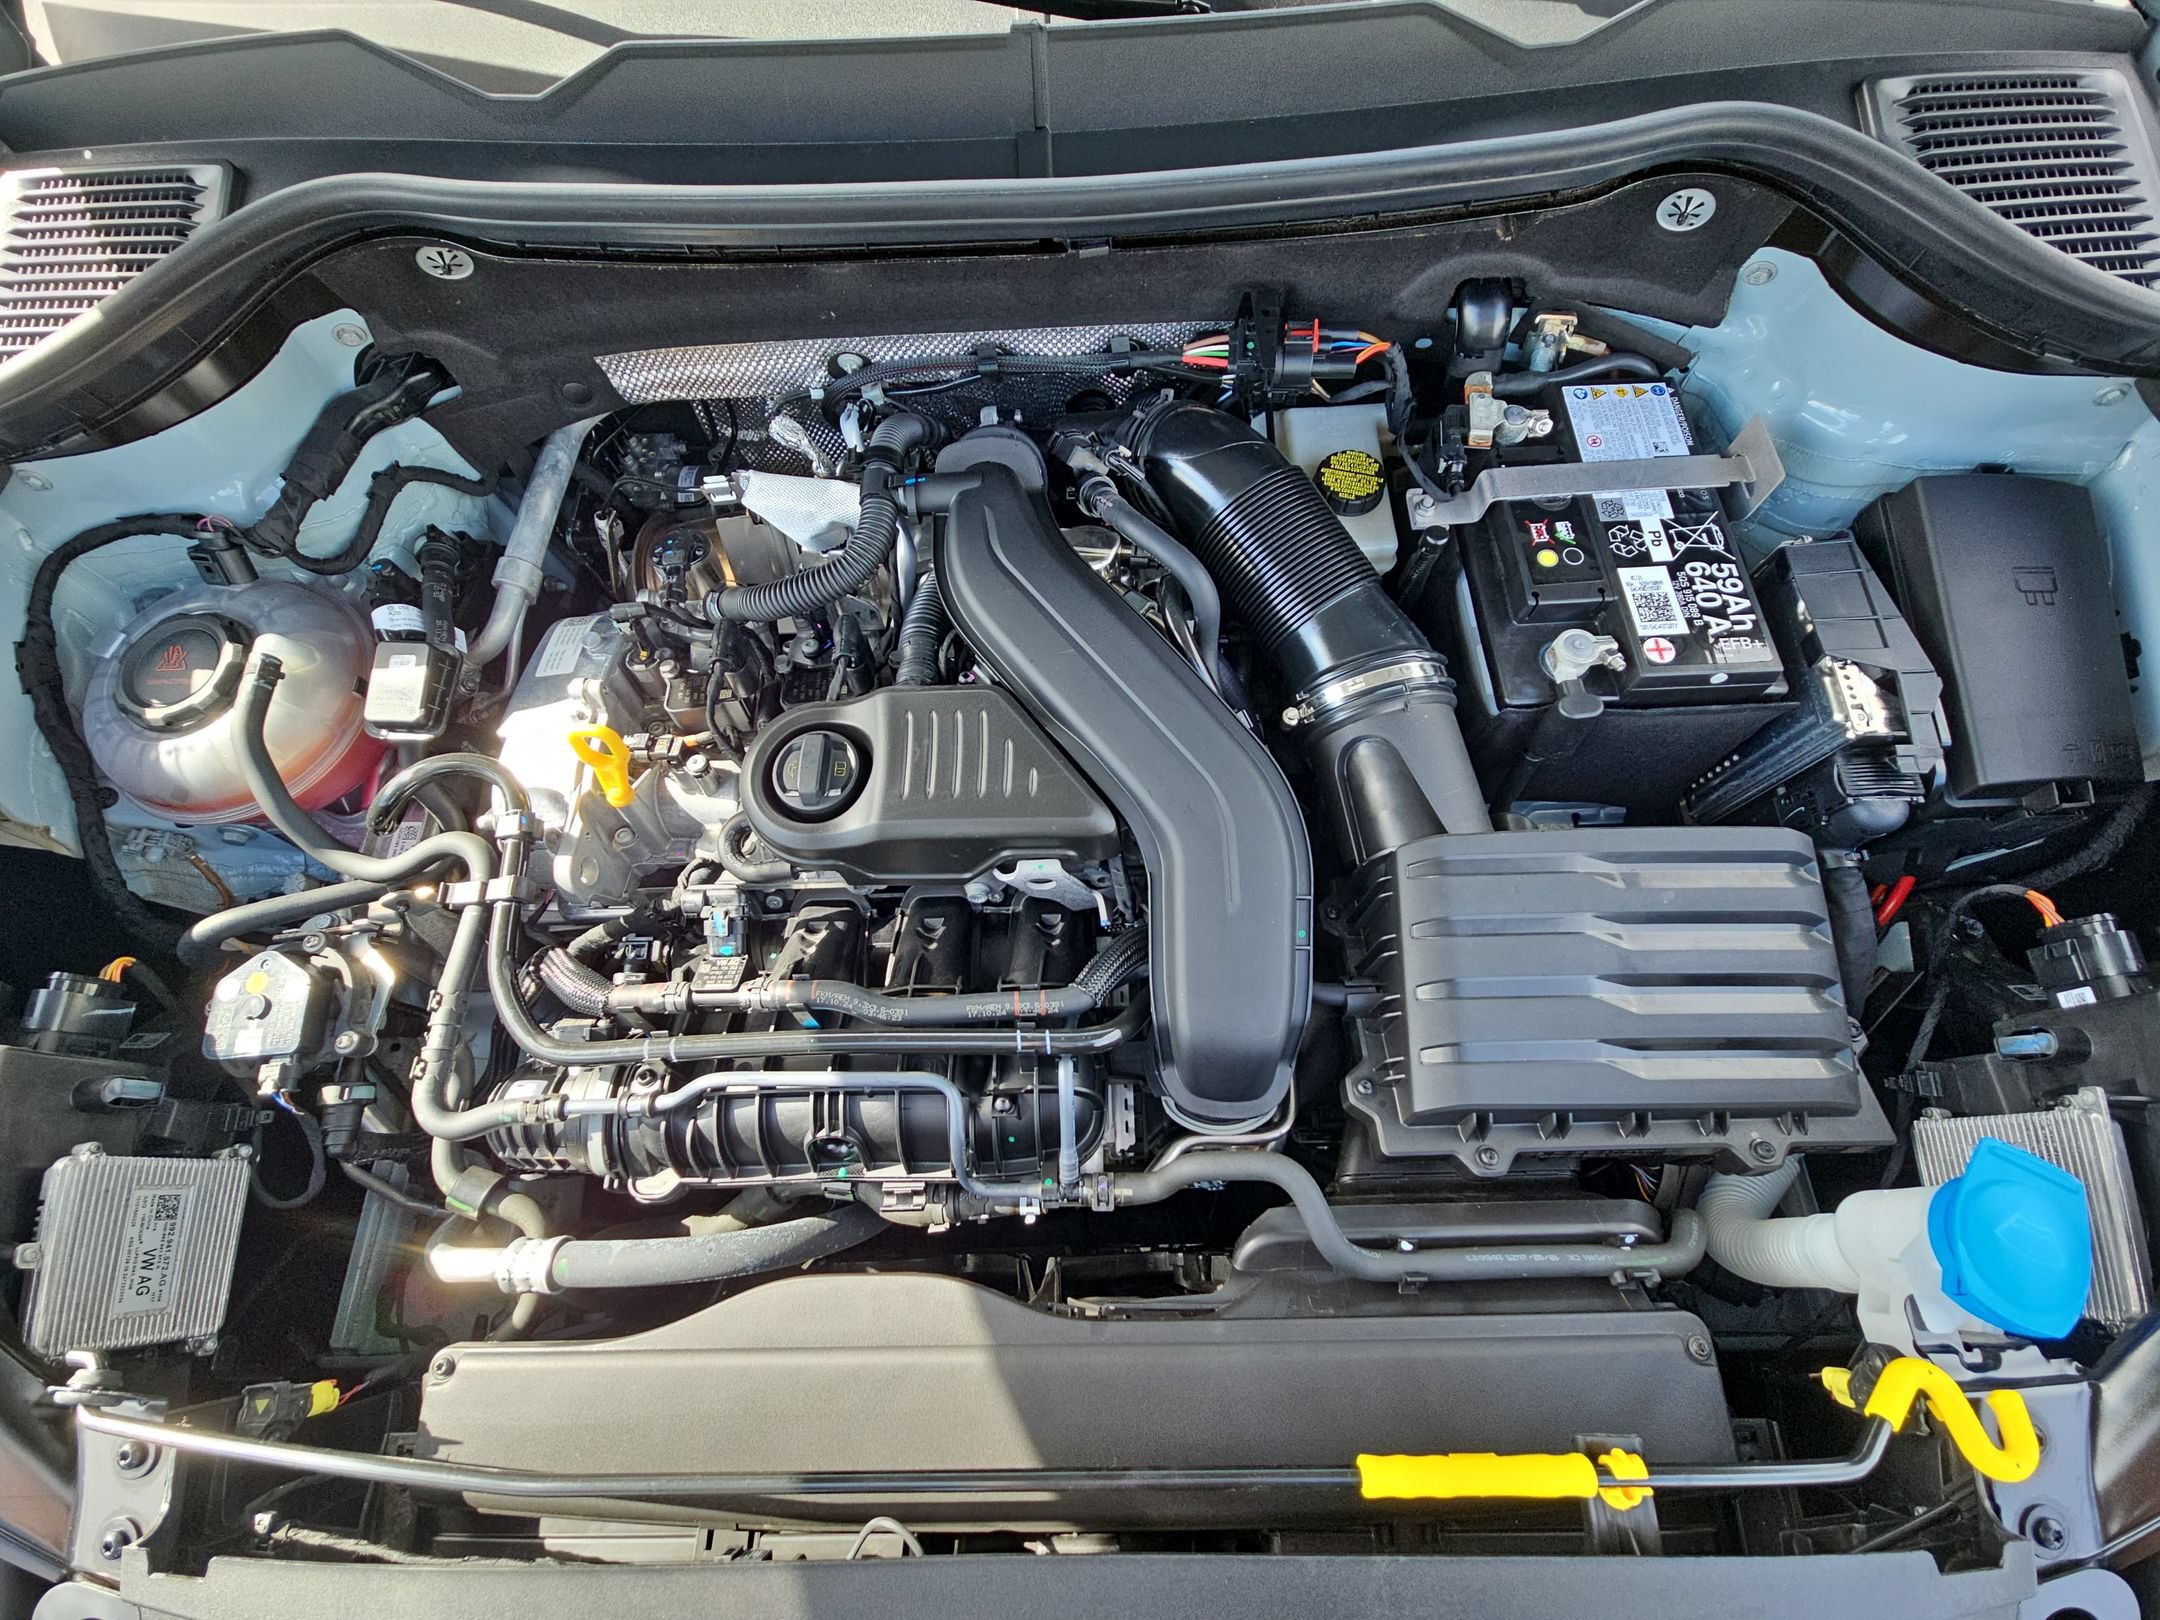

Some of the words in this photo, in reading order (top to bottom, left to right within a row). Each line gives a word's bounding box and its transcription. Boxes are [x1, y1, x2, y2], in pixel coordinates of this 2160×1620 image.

[1670, 396, 1695, 447] DANGER/POISON
[1648, 530, 1663, 547] Pb
[1685, 561, 1723, 608] 640
[1711, 562, 1757, 632] 59Ah
[1683, 589, 1692, 602] 915
[1688, 602, 1700, 618] 089
[1702, 614, 1733, 637] A
[140, 1248, 158, 1271] VW
[135, 1275, 152, 1296] AG
